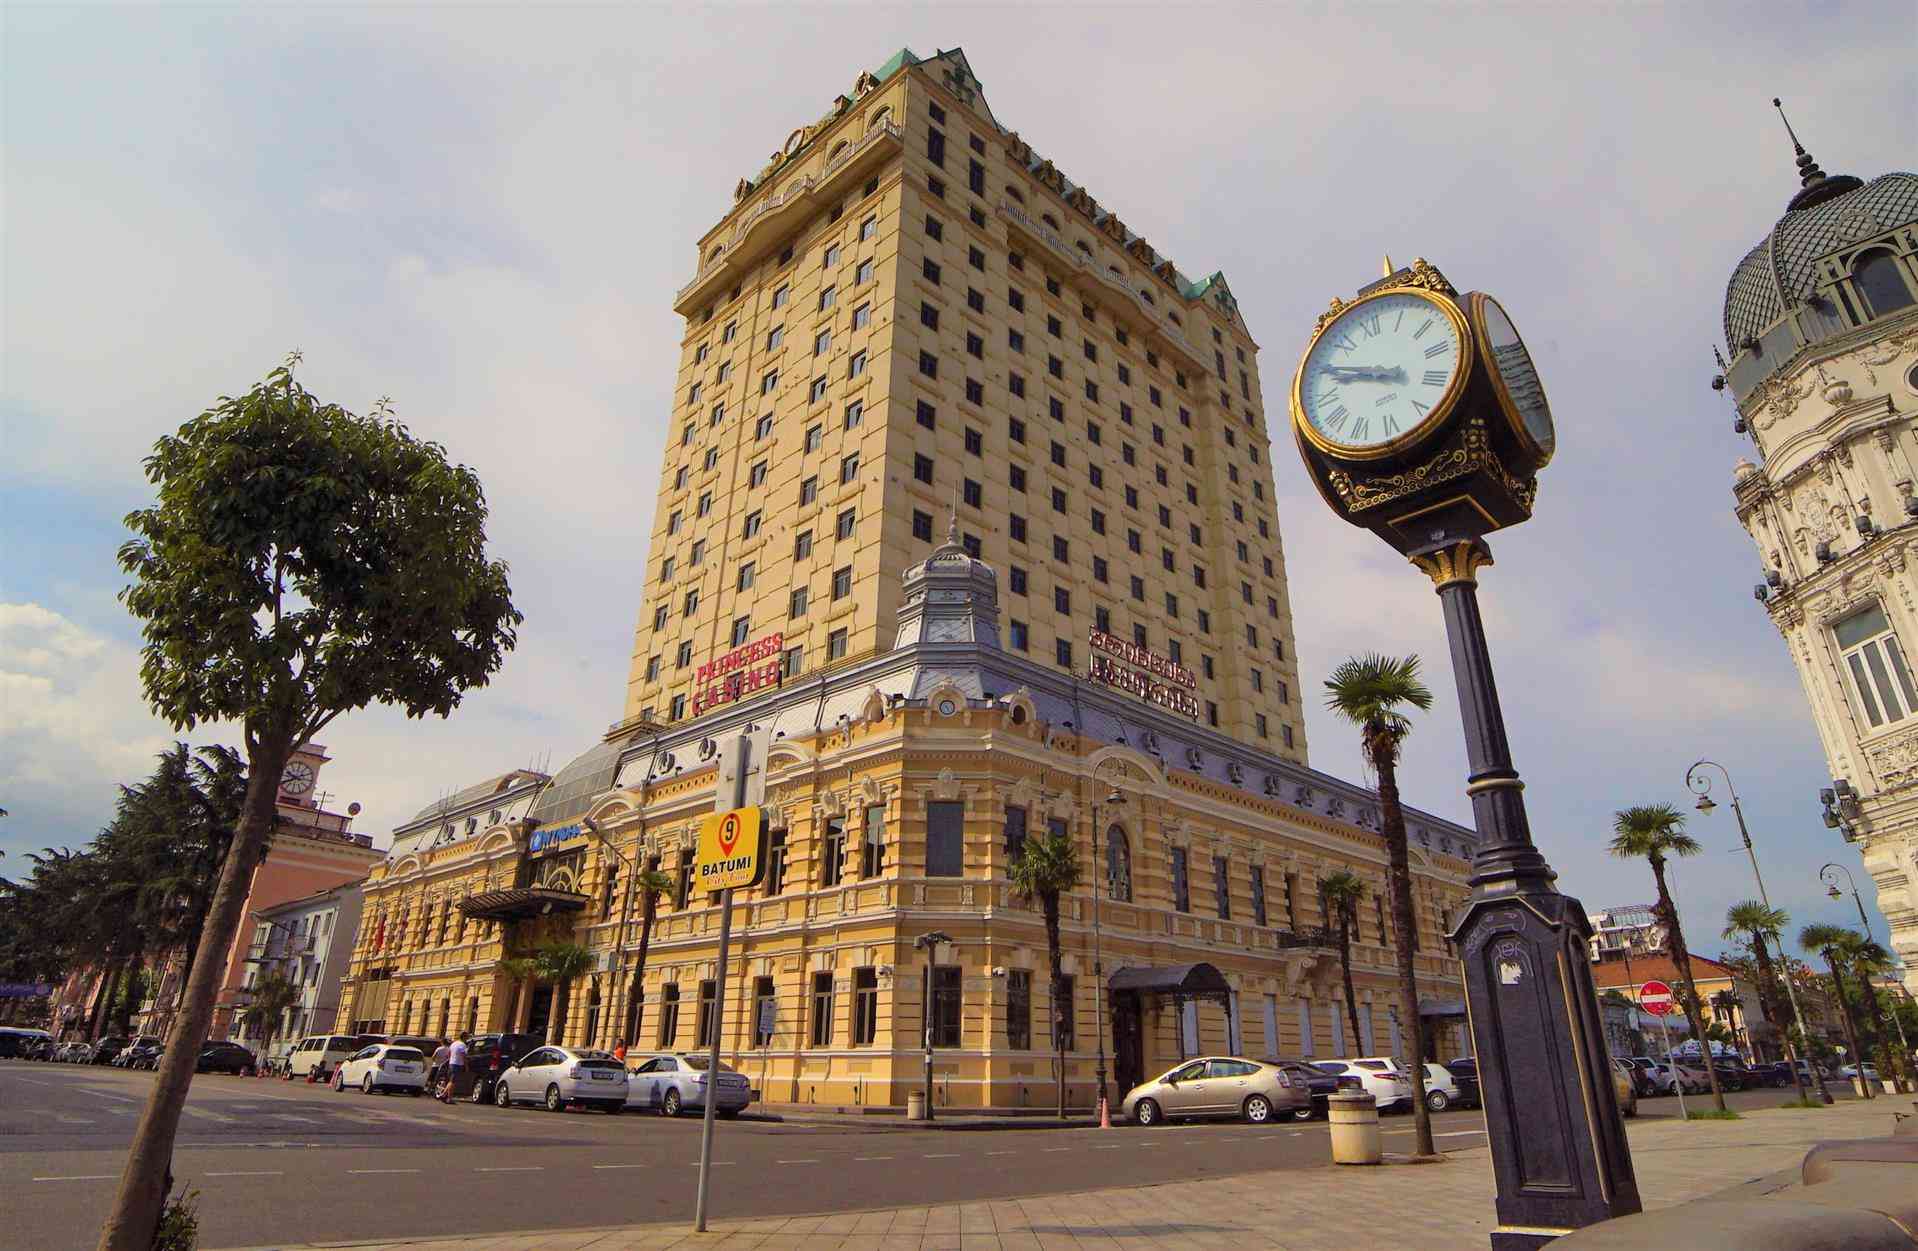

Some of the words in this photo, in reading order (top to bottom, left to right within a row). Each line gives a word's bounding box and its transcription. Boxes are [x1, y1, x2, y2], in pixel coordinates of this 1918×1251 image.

[1360, 314, 1381, 341] XII
[1413, 319, 1434, 341] II
[1334, 334, 1357, 358] XI
[1424, 340, 1449, 359] III
[1422, 370, 1449, 387] IIII
[696, 632, 783, 685] PRINCESS
[692, 661, 782, 717] CASINO
[725, 821, 734, 841] 9
[702, 856, 751, 876] BATUMI
